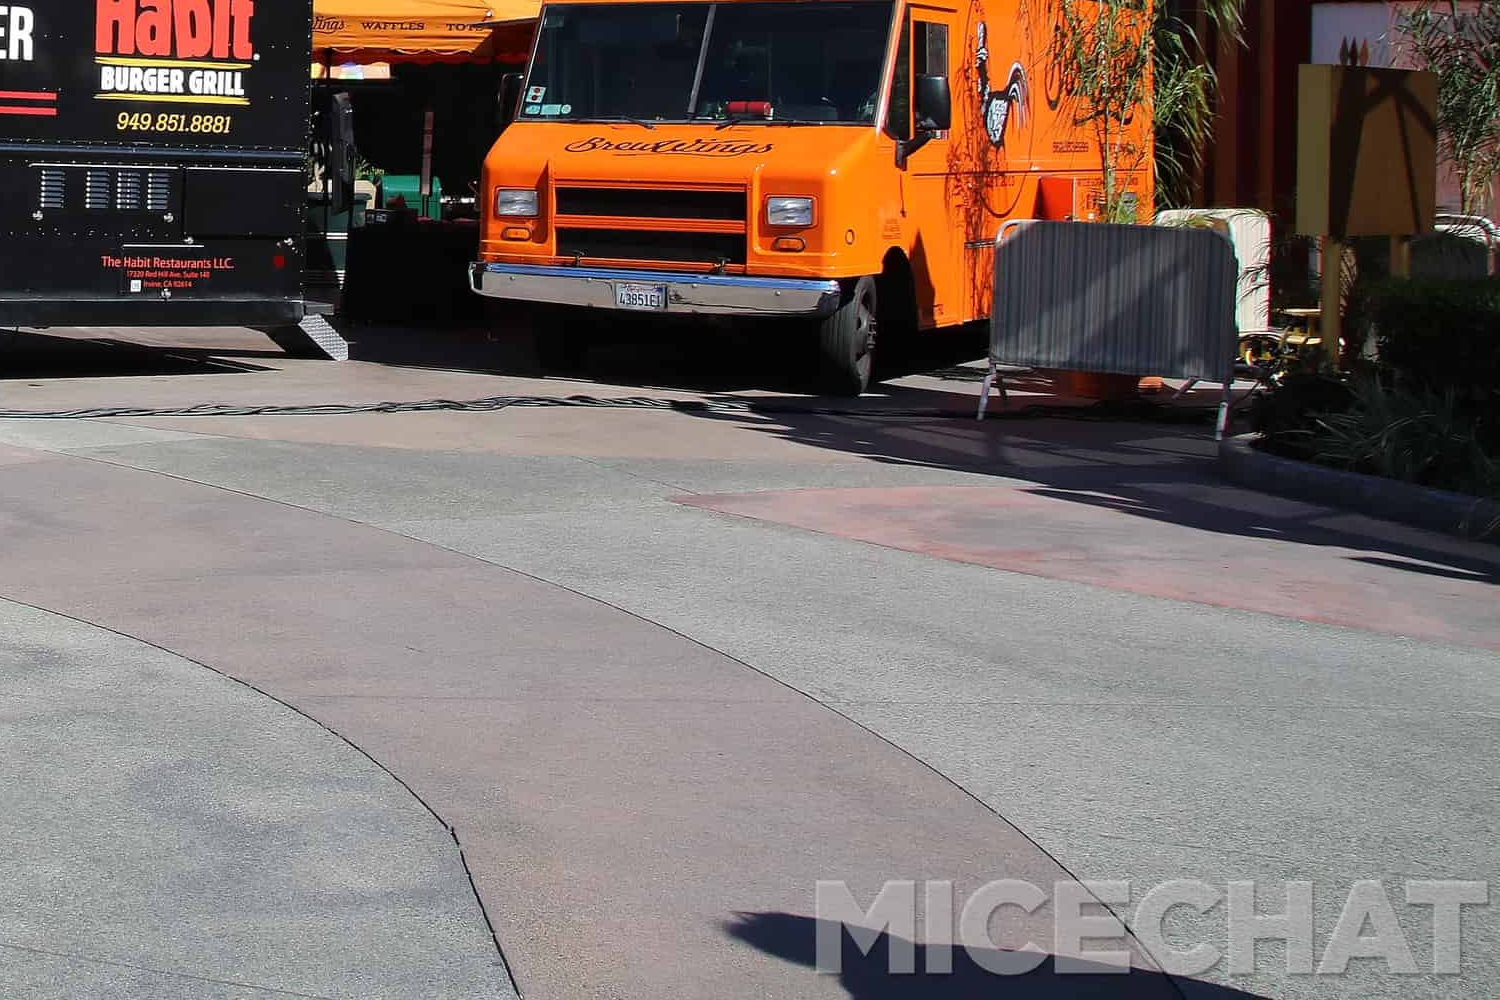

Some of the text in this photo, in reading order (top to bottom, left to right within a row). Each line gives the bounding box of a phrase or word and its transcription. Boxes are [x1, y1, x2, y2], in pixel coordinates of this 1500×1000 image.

[361, 21, 425, 31] WAFFLES
[101, 66, 245, 96] BURGER GRILL
[116, 111, 232, 134] 949.851.8881
[100, 256, 120, 268] The
[123, 256, 151, 268] Habit
[153, 257, 212, 269] Restaurants
